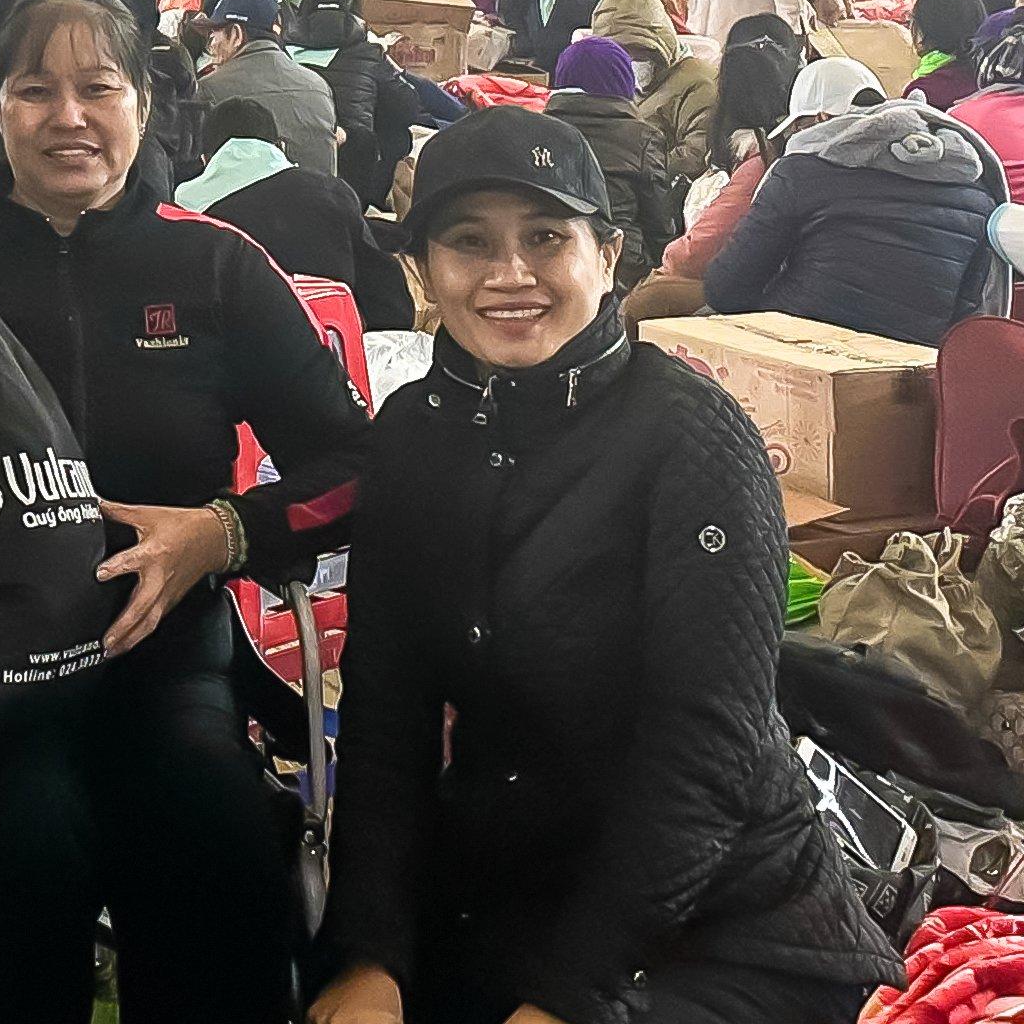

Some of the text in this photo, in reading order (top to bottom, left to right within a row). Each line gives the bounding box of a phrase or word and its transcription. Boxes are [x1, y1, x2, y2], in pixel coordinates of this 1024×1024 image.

[22, 508, 57, 528] Quý
[57, 506, 81, 524] ông
[3, 669, 56, 683] Hotline:
